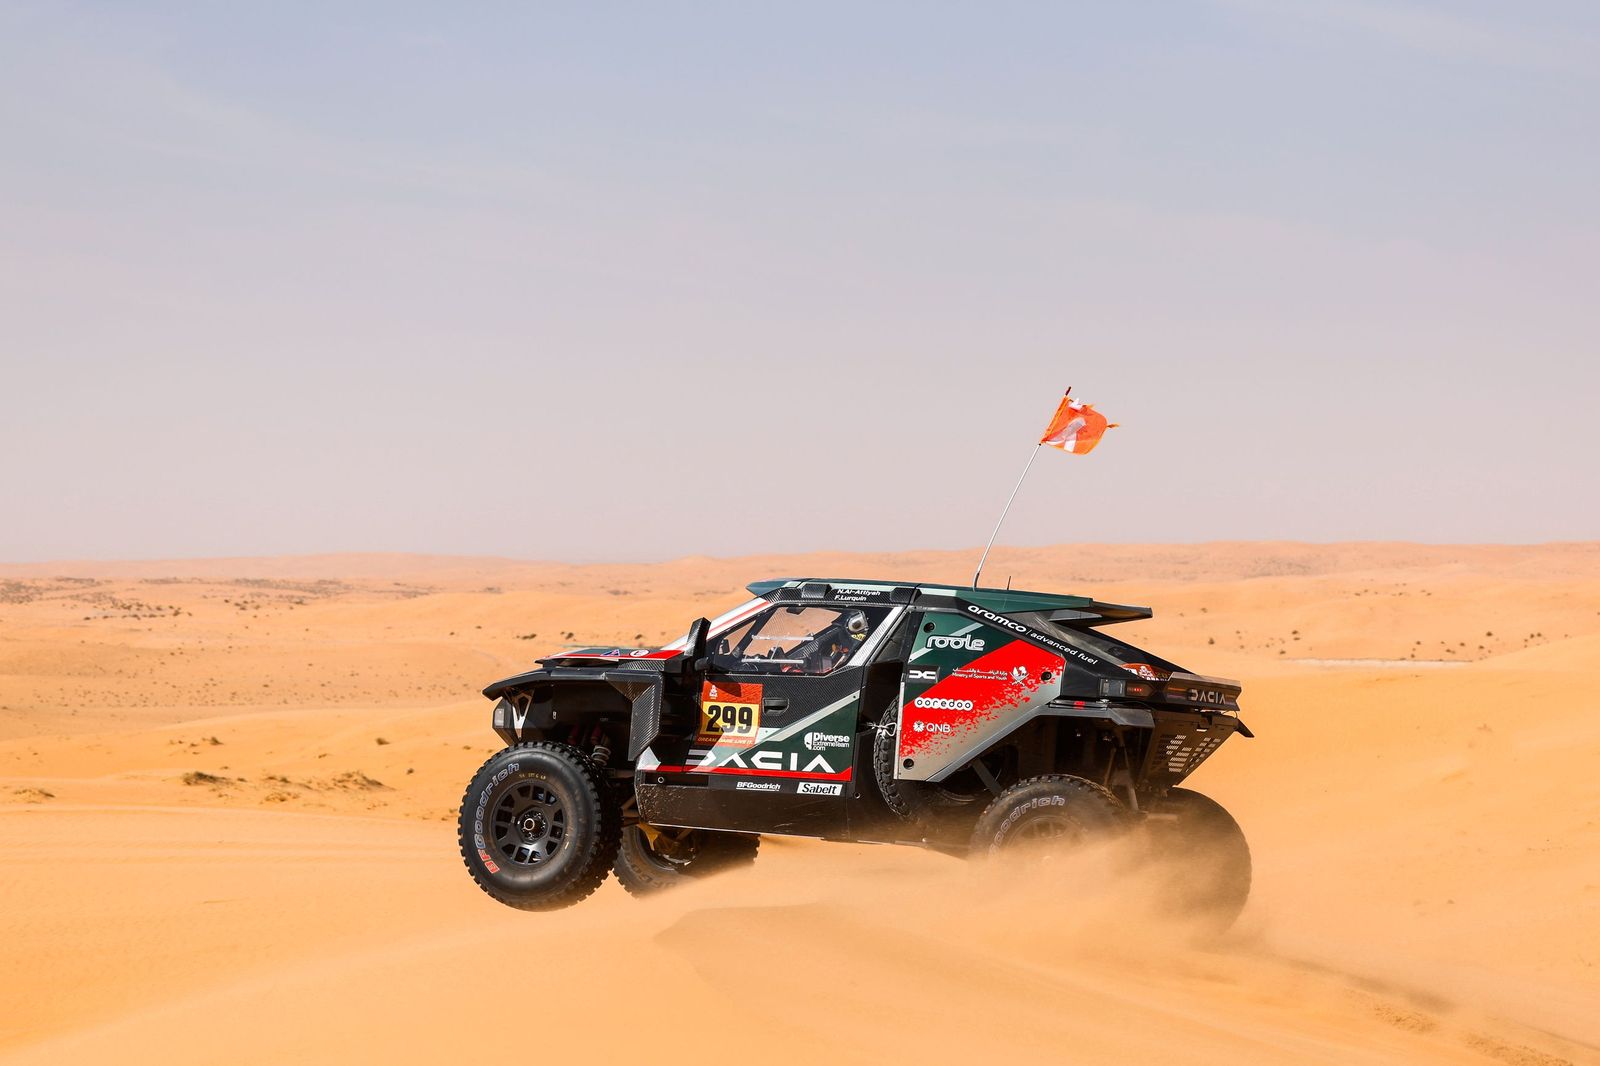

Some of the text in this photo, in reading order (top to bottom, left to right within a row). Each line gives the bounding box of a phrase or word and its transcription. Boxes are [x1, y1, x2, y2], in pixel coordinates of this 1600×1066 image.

[967, 605, 1098, 665] aramco advanced fuel
[1190, 688, 1226, 705] DACIA
[915, 698, 972, 709] ooredoo
[706, 705, 753, 734] 299
[926, 723, 951, 733] QNB
[813, 732, 850, 743] Diverse
[685, 748, 836, 774] DACIA
[736, 781, 781, 790] BFGoodrich
[801, 783, 837, 795] Sabelt
